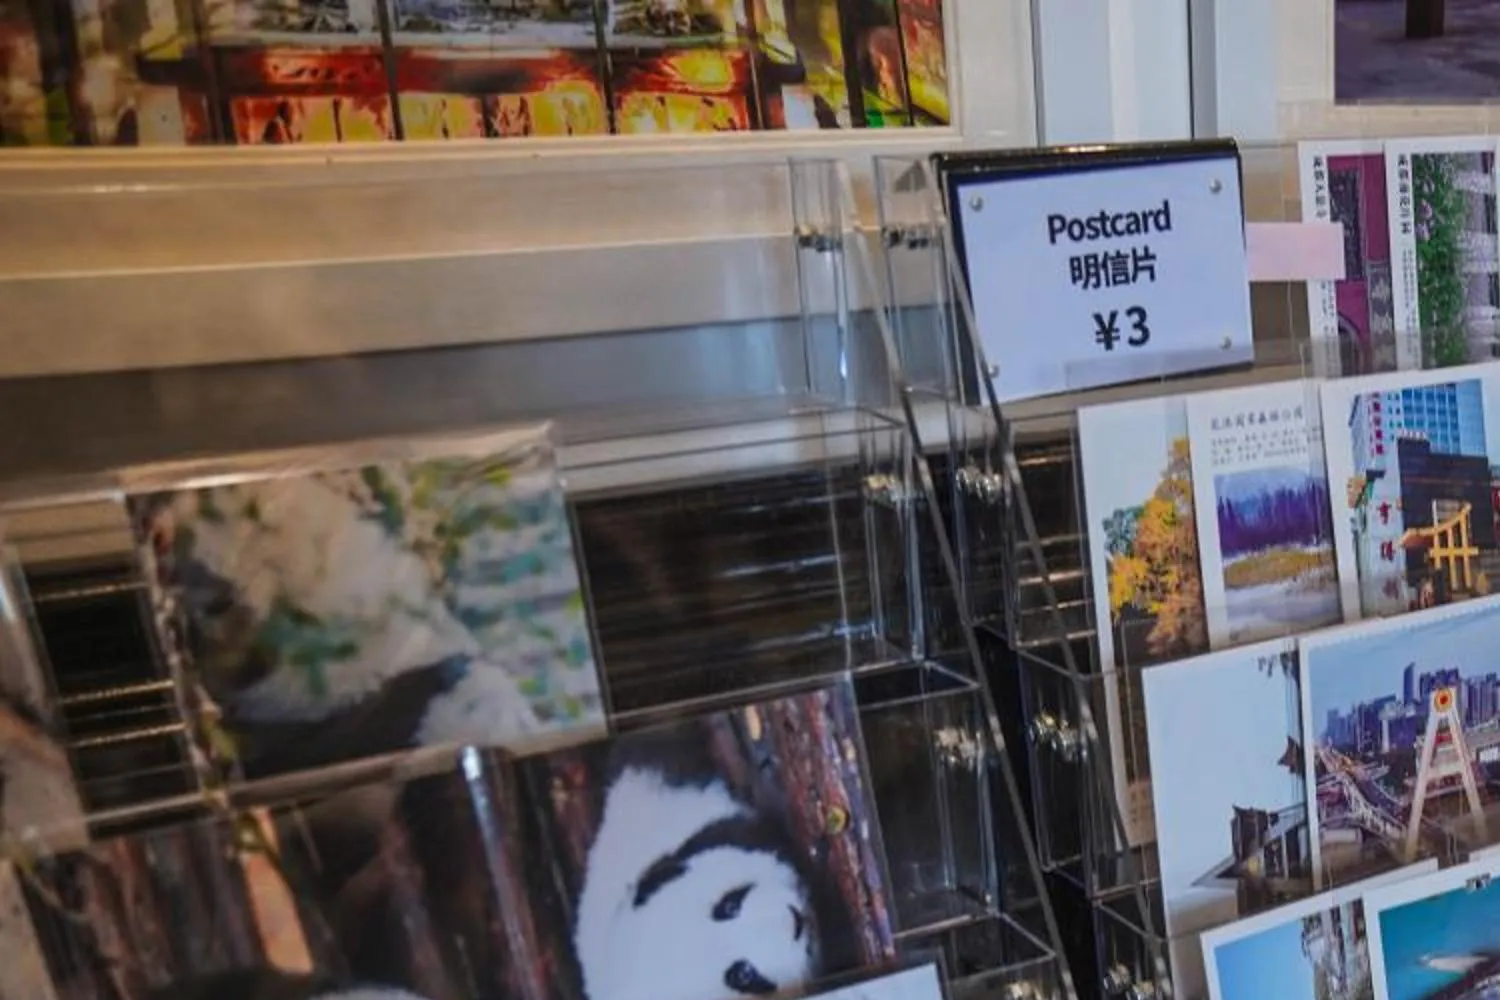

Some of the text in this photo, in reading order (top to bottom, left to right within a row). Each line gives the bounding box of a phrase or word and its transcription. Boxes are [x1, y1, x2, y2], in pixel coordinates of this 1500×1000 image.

[1047, 199, 1172, 245] Postcard
[1069, 246, 1157, 290] 明信片
[1093, 306, 1151, 351] ¥3
